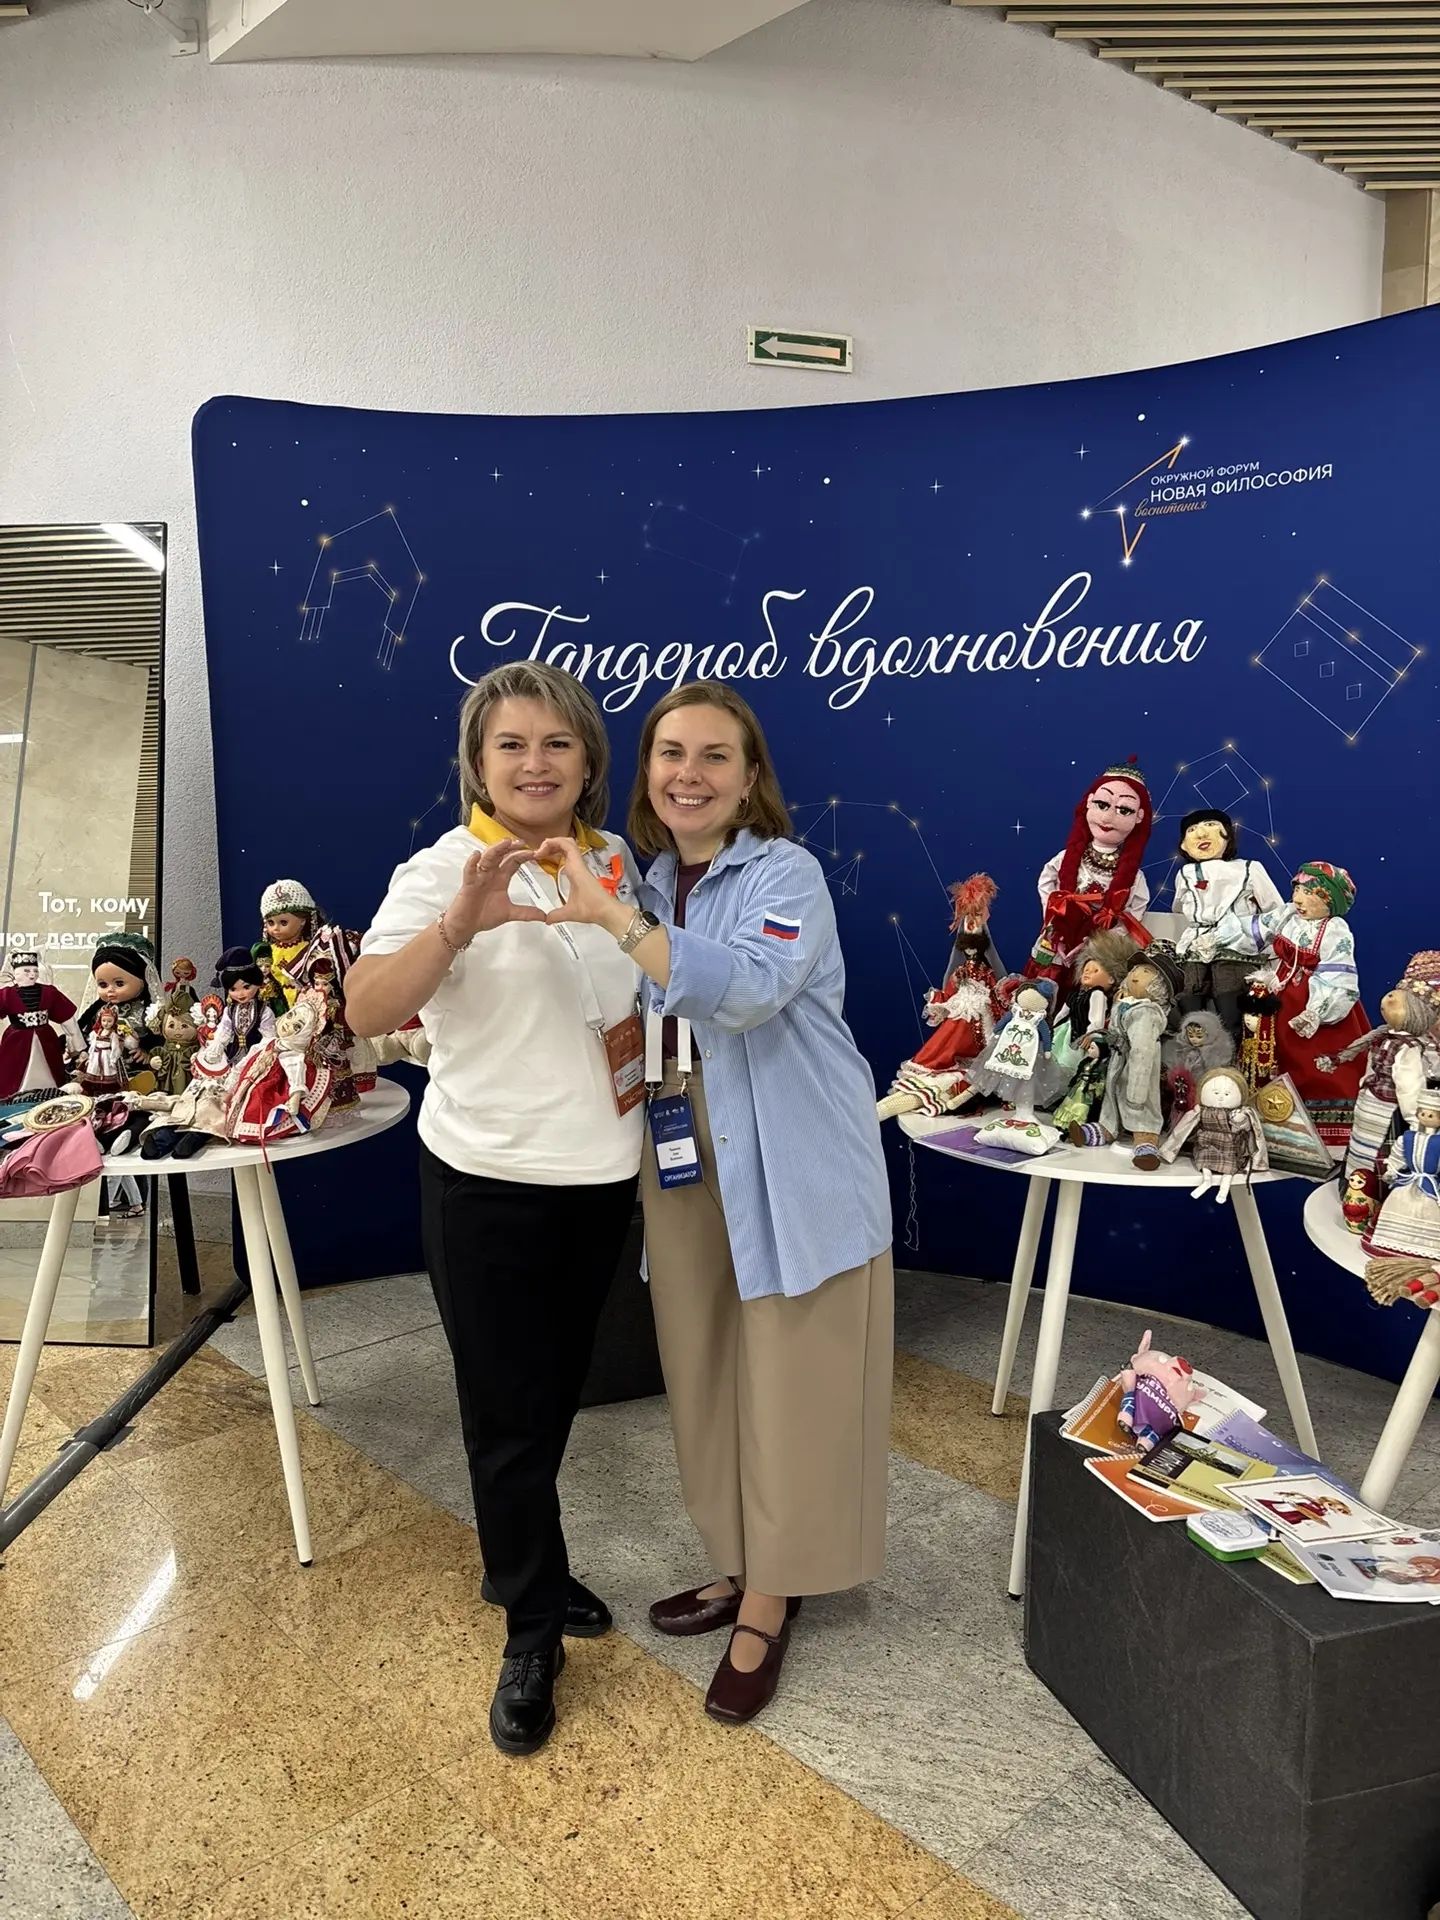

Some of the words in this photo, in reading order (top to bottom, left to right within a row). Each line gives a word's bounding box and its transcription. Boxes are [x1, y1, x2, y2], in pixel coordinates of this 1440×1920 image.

[1150, 465, 1214, 486] ОКРУЖНОЙ
[1216, 461, 1260, 477] ФОРУМ
[1150, 483, 1206, 503] НОВАЯ
[1210, 463, 1334, 496] ФИЛОСОФИЯ
[802, 571, 1208, 711] вдохновения
[38, 891, 82, 918] Тот,
[90, 897, 150, 920] кому
[0, 931, 39, 948] ют
